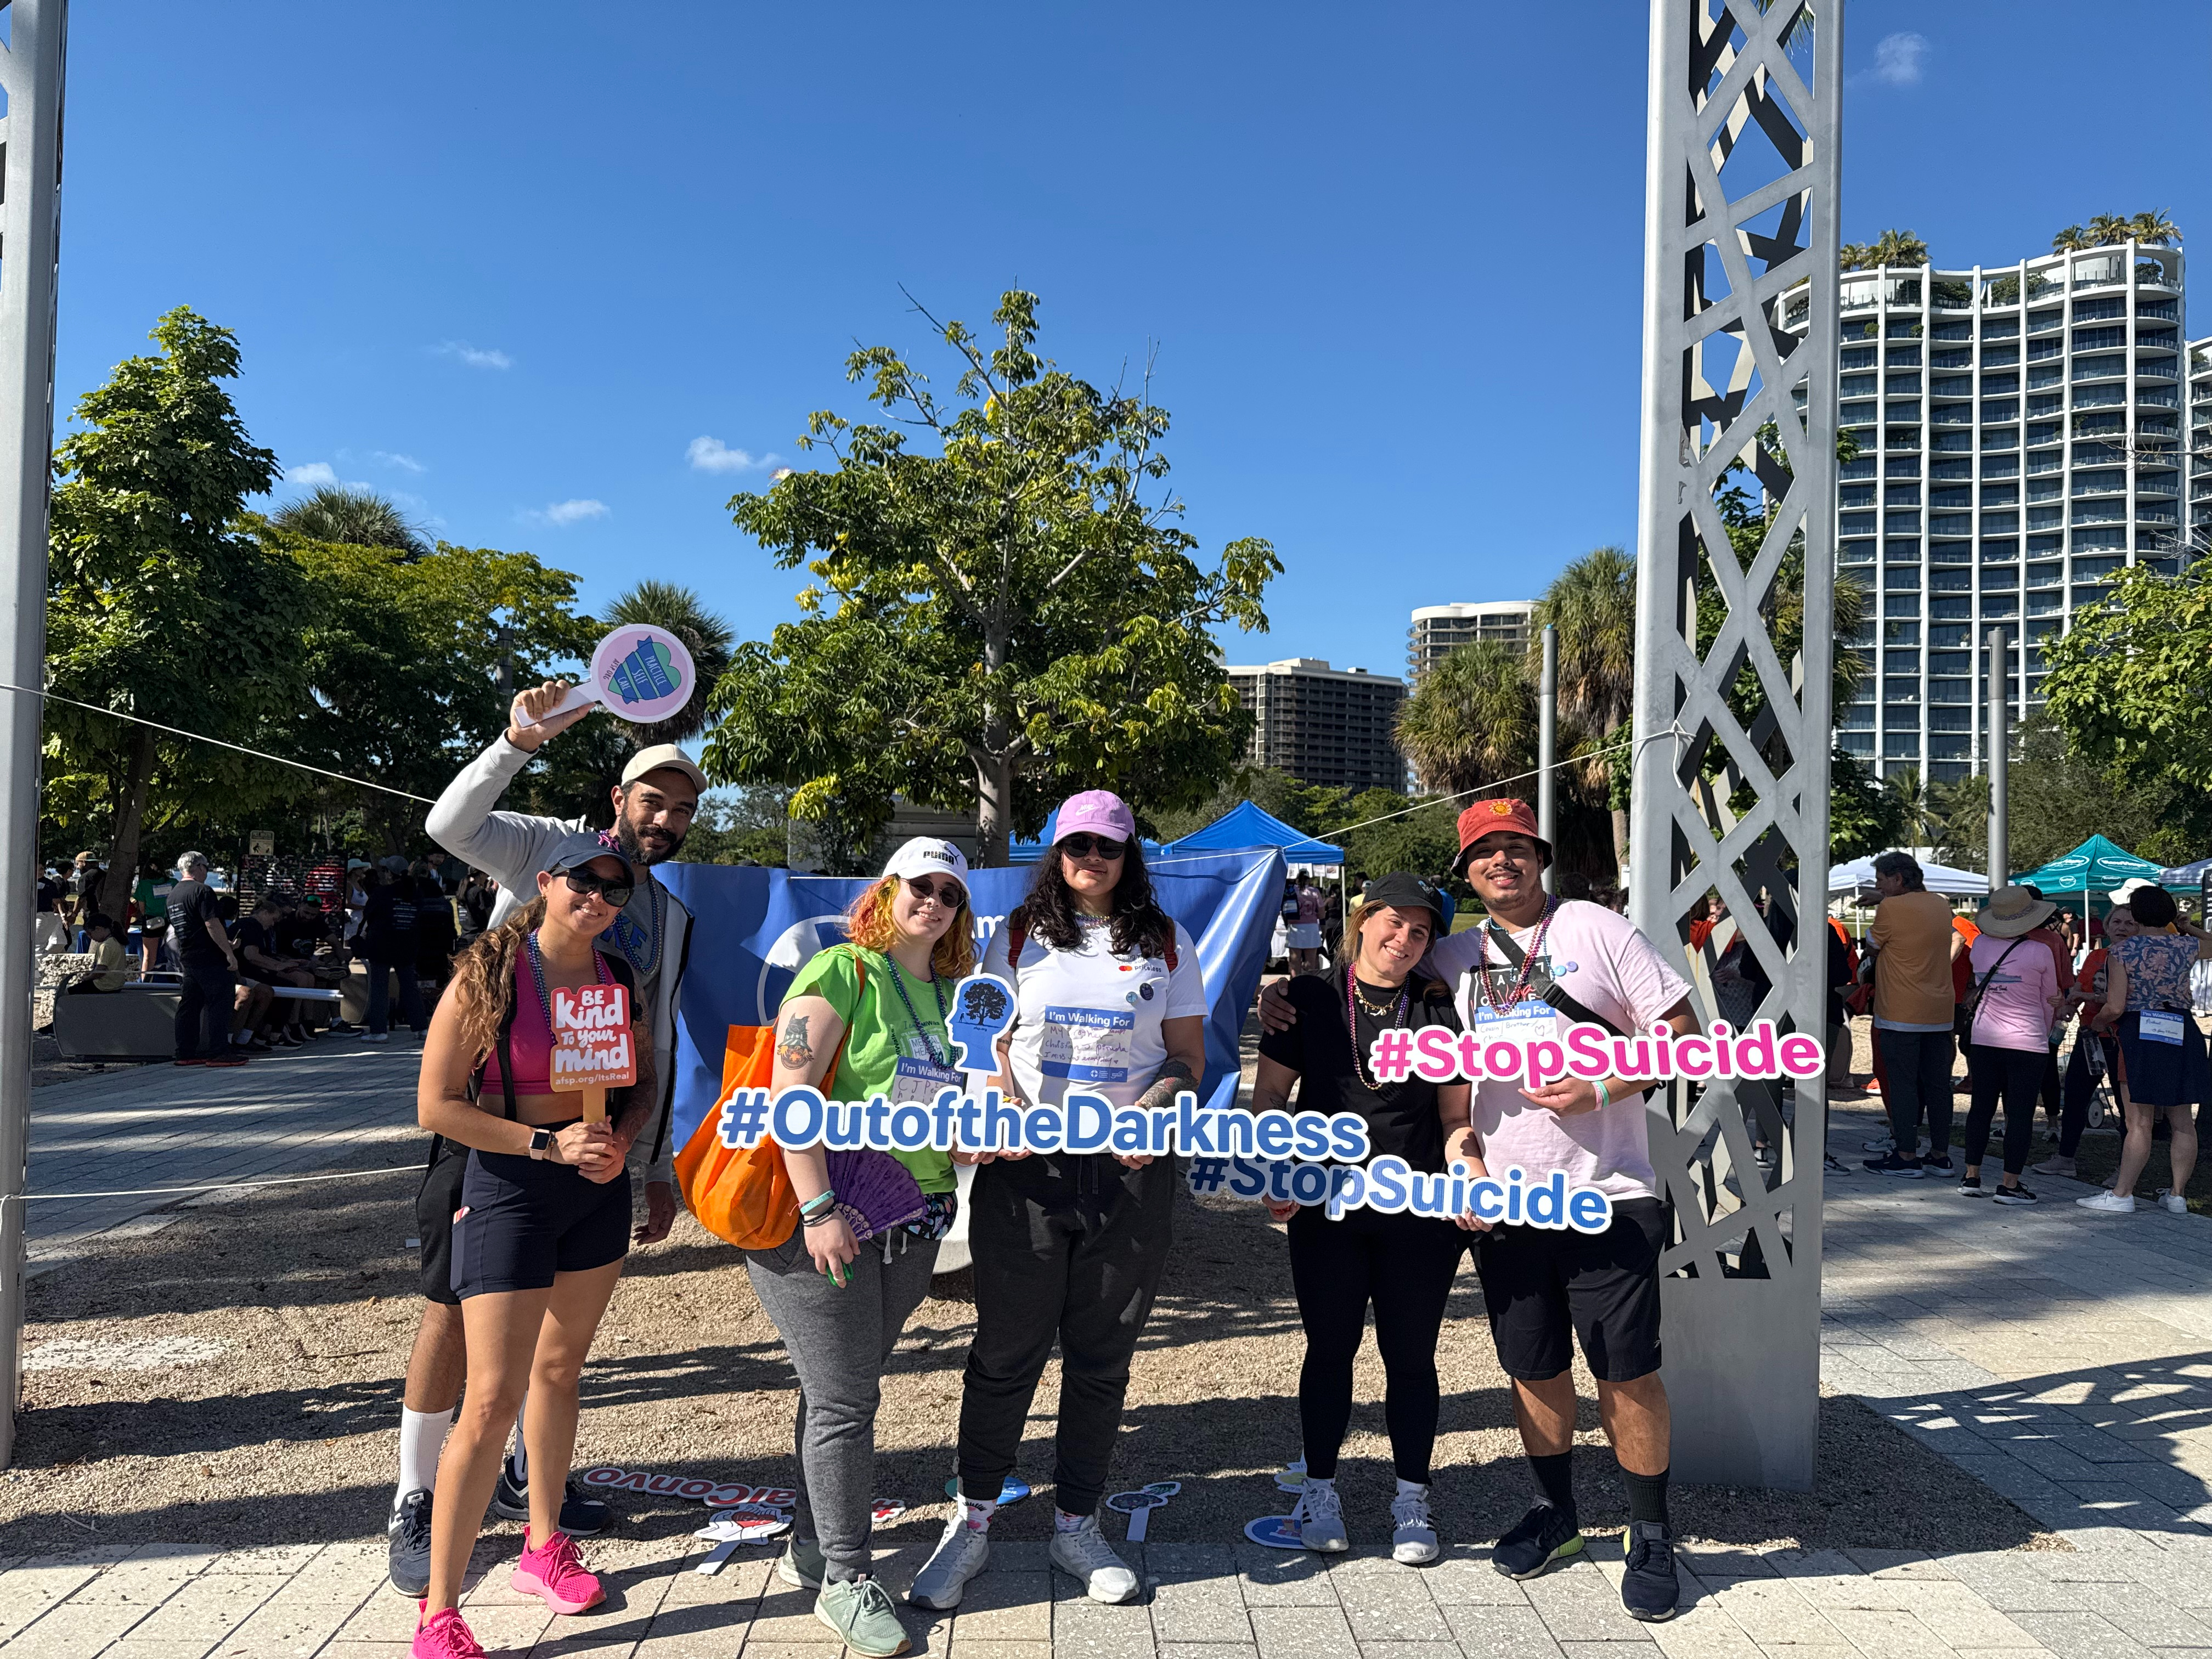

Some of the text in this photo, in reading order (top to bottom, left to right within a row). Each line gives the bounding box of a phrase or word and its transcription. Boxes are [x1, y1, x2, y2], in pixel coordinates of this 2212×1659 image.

[631, 669, 648, 684] SELF
[645, 655, 667, 685] PRACTICE
[617, 676, 631, 691] CARE
[923, 851, 955, 865] PUMA
[1134, 964, 1161, 973] priceless
[582, 990, 605, 1006] BE
[1049, 1011, 1131, 1028] I'm Walking For
[1479, 1012, 1493, 1021] I'm
[1533, 1006, 1551, 1015] For
[578, 1029, 617, 1048] your
[911, 1036, 940, 1047] MEAL
[555, 1034, 630, 1073] mind
[1373, 1024, 1821, 1088] #StopSuicide
[555, 1071, 629, 1085] afsp.org/ItsReal
[901, 1062, 962, 1083] I'm Walking For
[722, 1090, 1365, 1158] #OutoftheDarkness
[1190, 1158, 1607, 1228] #StopSuicide
